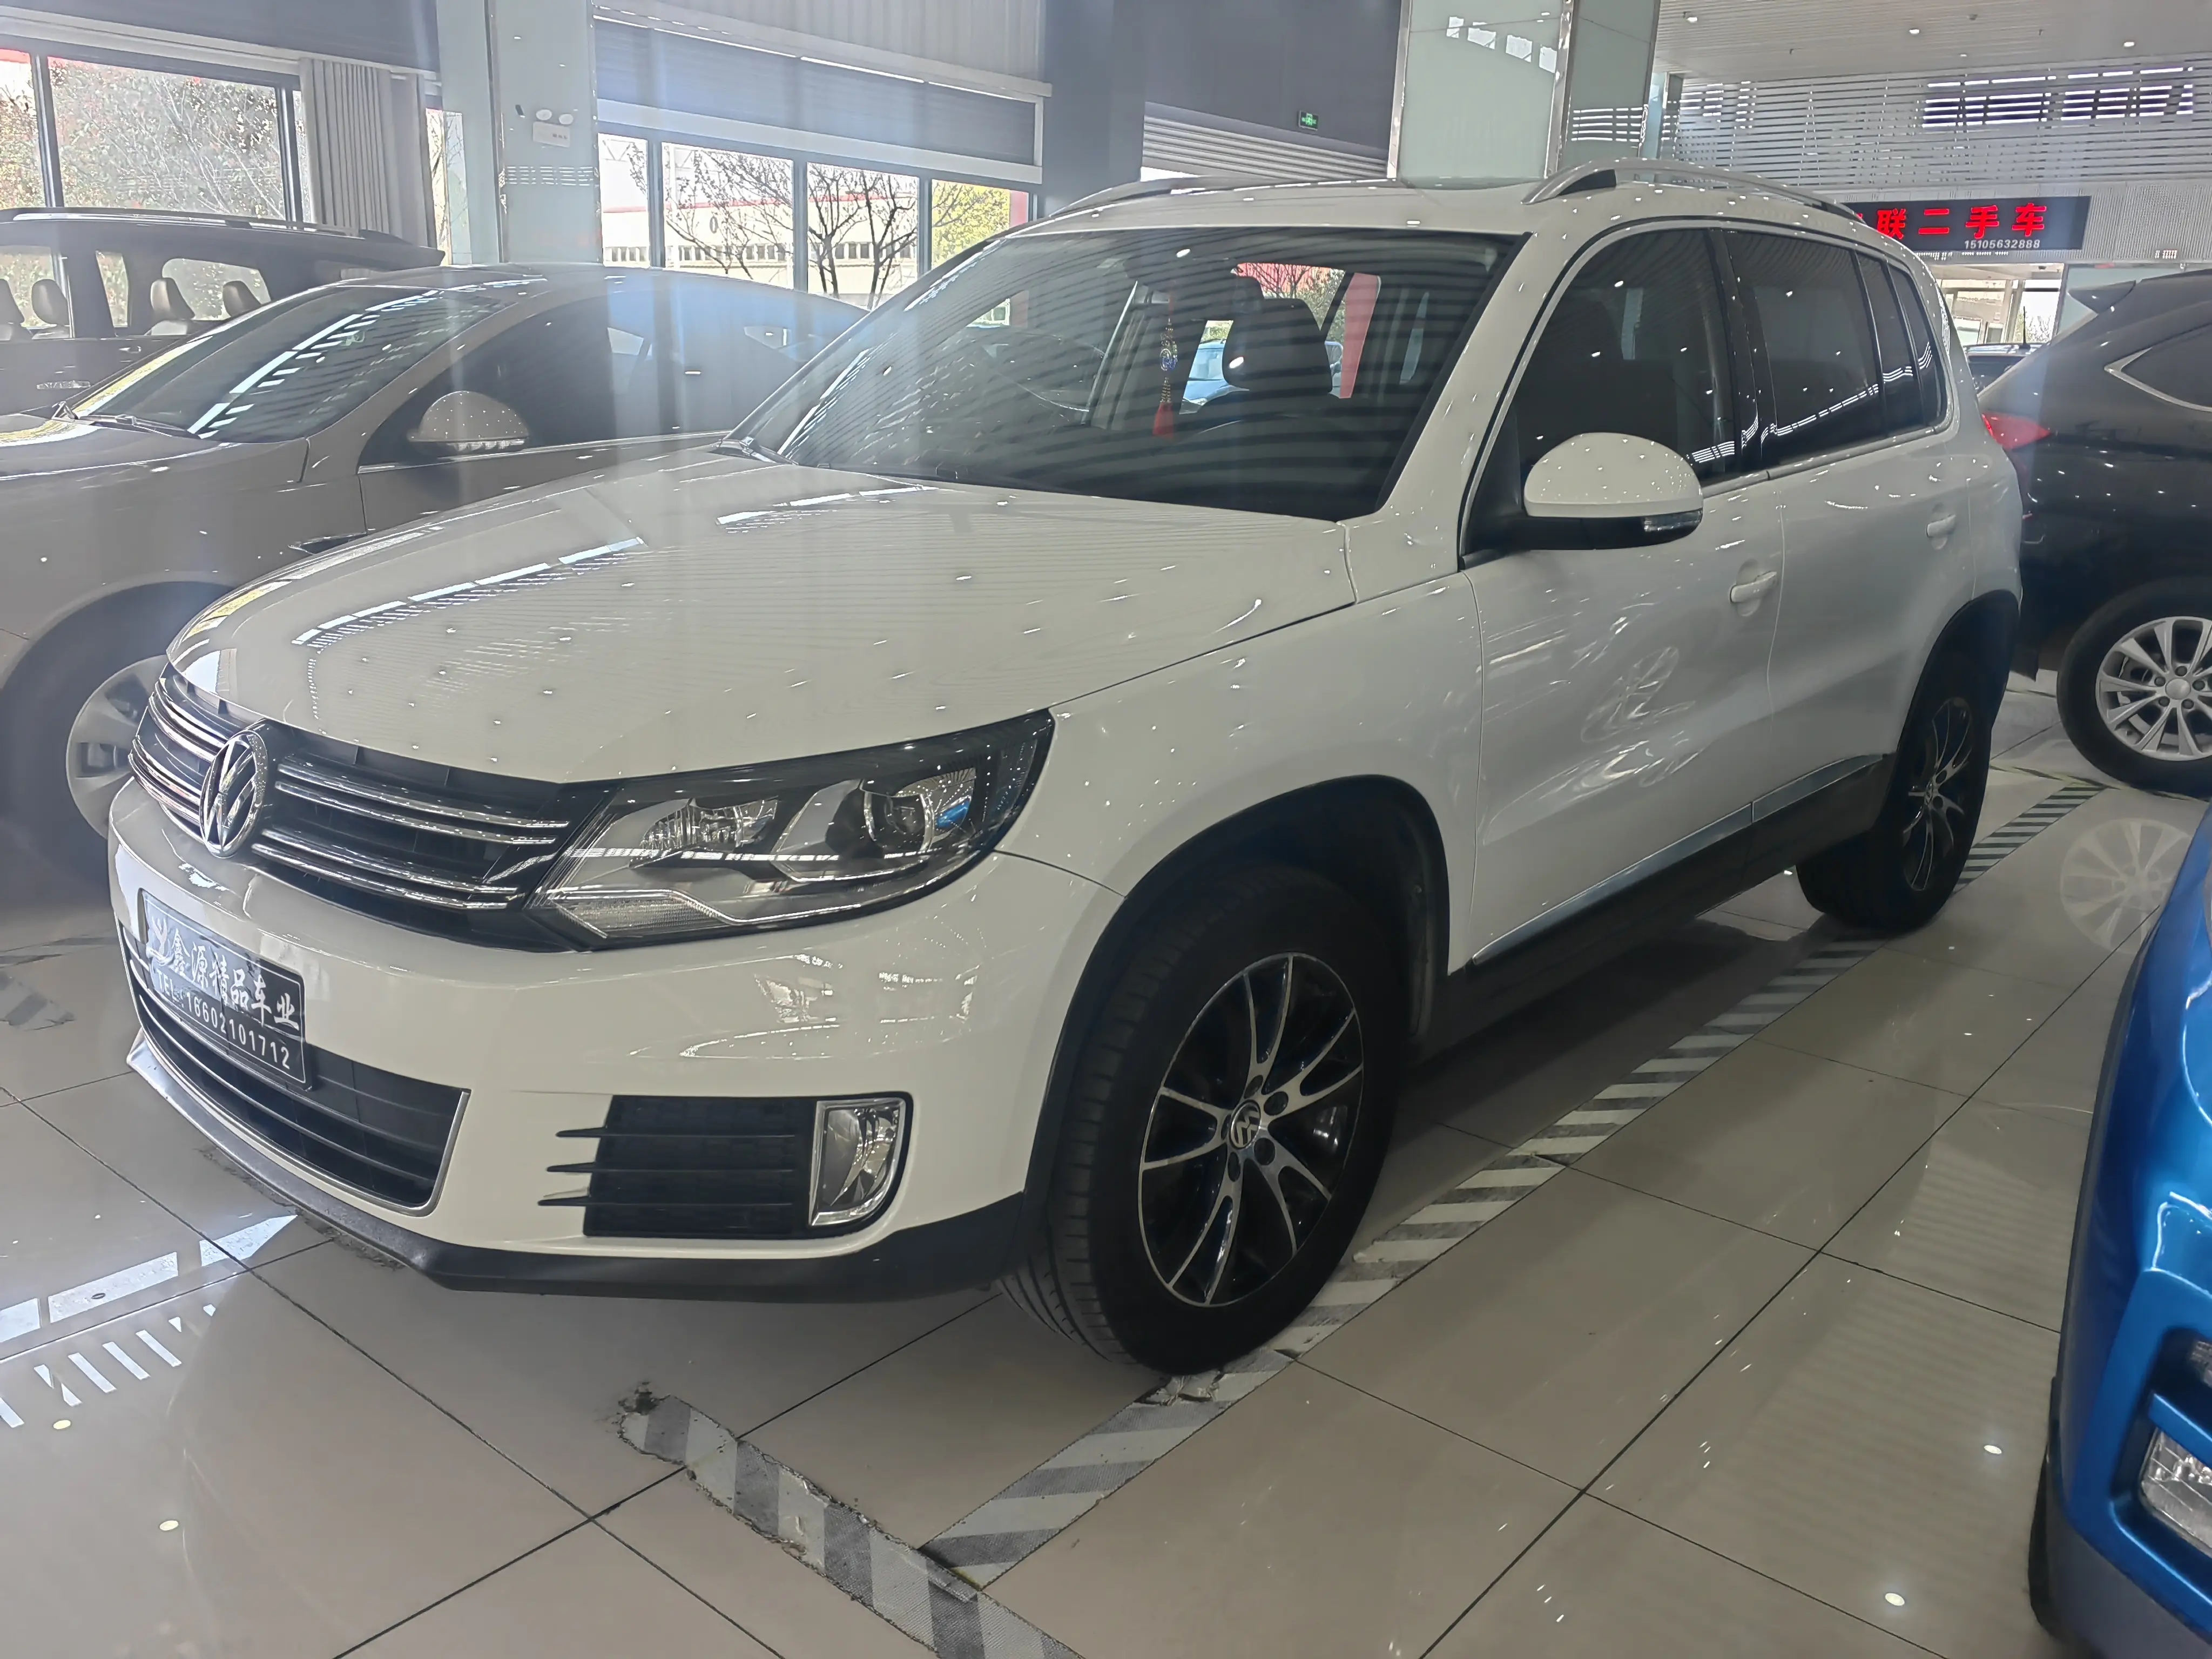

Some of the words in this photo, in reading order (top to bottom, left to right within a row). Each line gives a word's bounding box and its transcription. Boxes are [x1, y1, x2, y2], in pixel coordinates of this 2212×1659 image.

[1856, 203, 2047, 239] 联二手车
[1964, 239, 2041, 250] 15105632888
